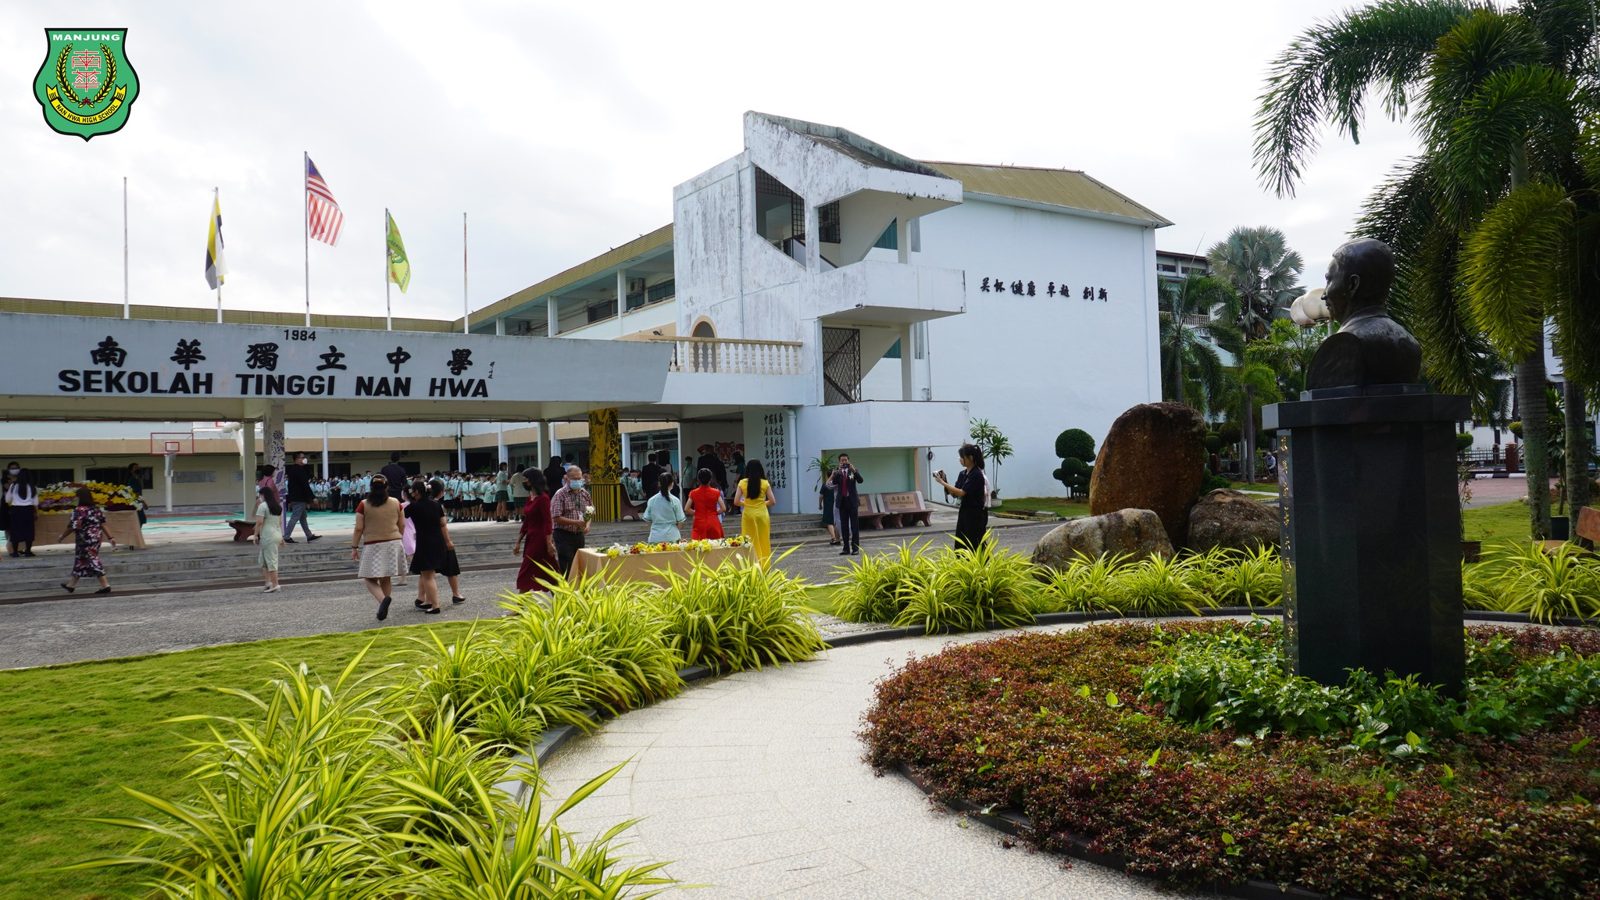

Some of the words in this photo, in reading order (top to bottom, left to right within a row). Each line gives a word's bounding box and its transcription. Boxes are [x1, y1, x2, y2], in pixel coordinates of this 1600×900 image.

[283, 329, 317, 342] 1984
[90, 335, 474, 376] 南華獨立中學
[58, 369, 213, 395] SEKOLAH
[235, 373, 335, 396] TINGGI
[355, 375, 412, 397] NAN
[429, 377, 489, 398] HWA
